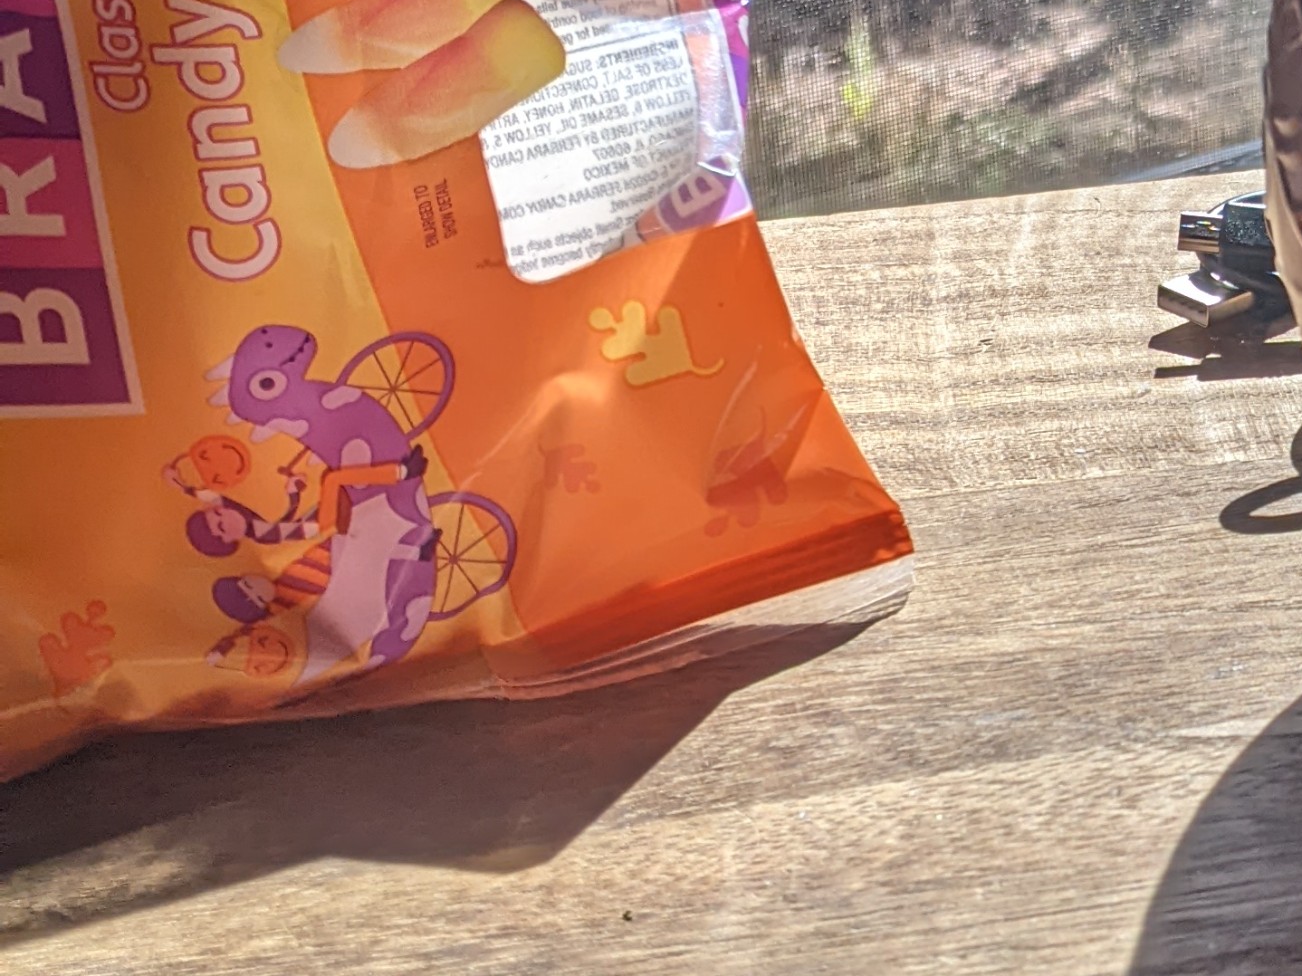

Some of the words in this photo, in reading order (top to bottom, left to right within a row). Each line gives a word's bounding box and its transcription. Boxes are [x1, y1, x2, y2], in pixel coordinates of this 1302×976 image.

[413, 185, 429, 201] TO
[435, 177, 453, 212] DETAIL
[418, 200, 439, 248] ENLARGED
[441, 212, 458, 239] SHOW
